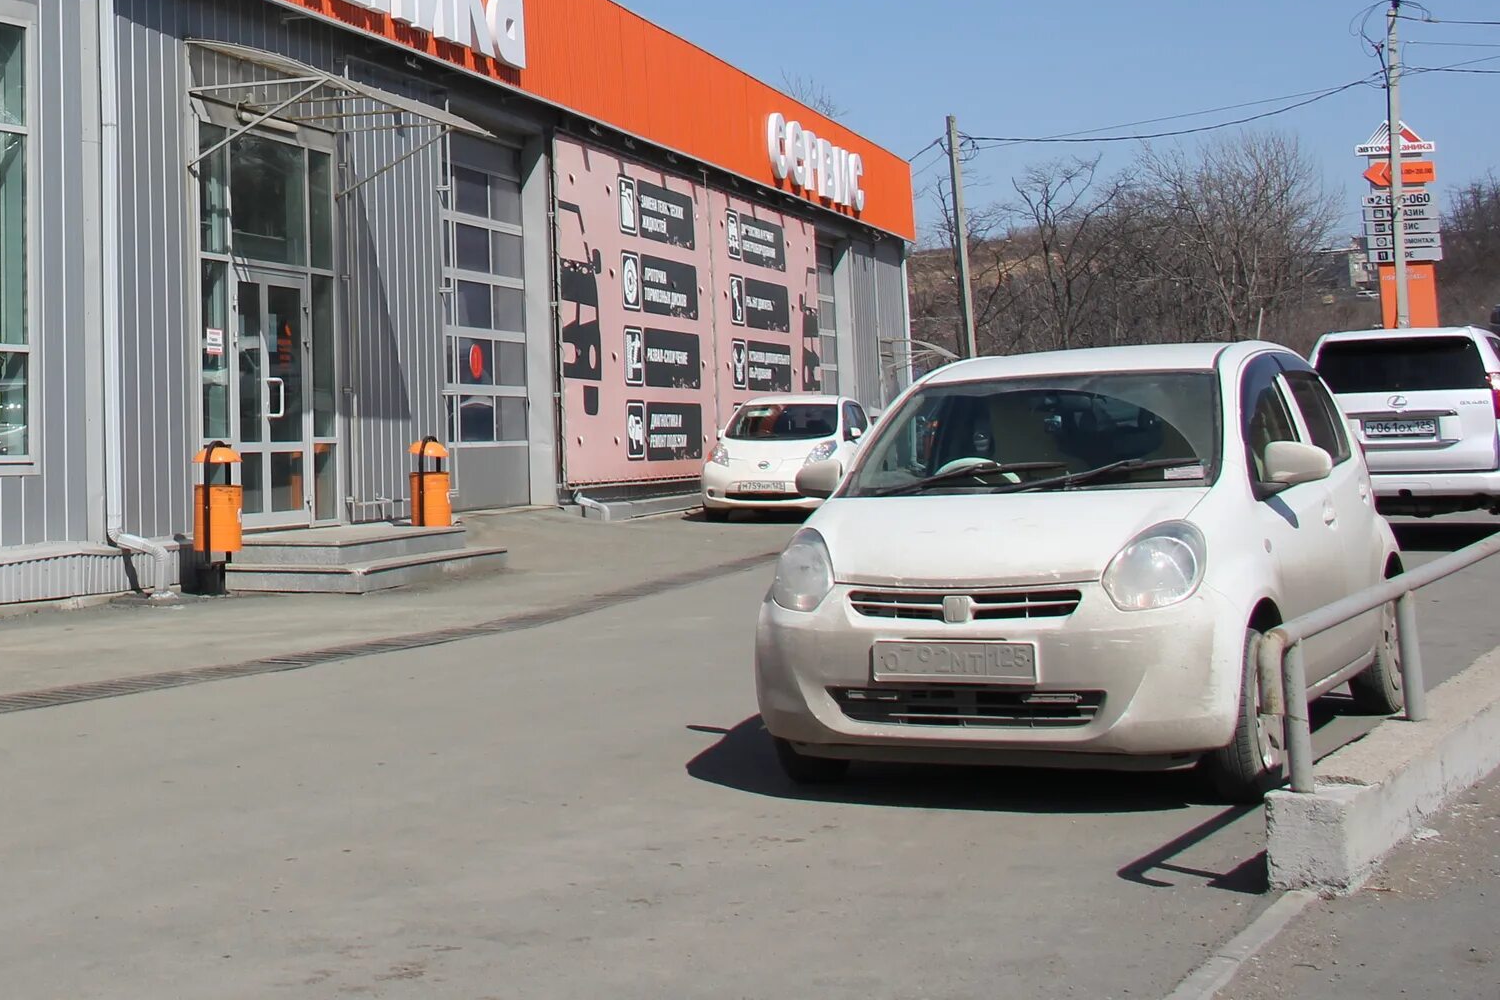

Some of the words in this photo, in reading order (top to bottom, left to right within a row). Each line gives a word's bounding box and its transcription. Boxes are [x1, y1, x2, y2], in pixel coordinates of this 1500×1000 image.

[1357, 143, 1432, 153] автоманика
[1387, 209, 1424, 217] МАЗИН
[987, 645, 1027, 668] 125
